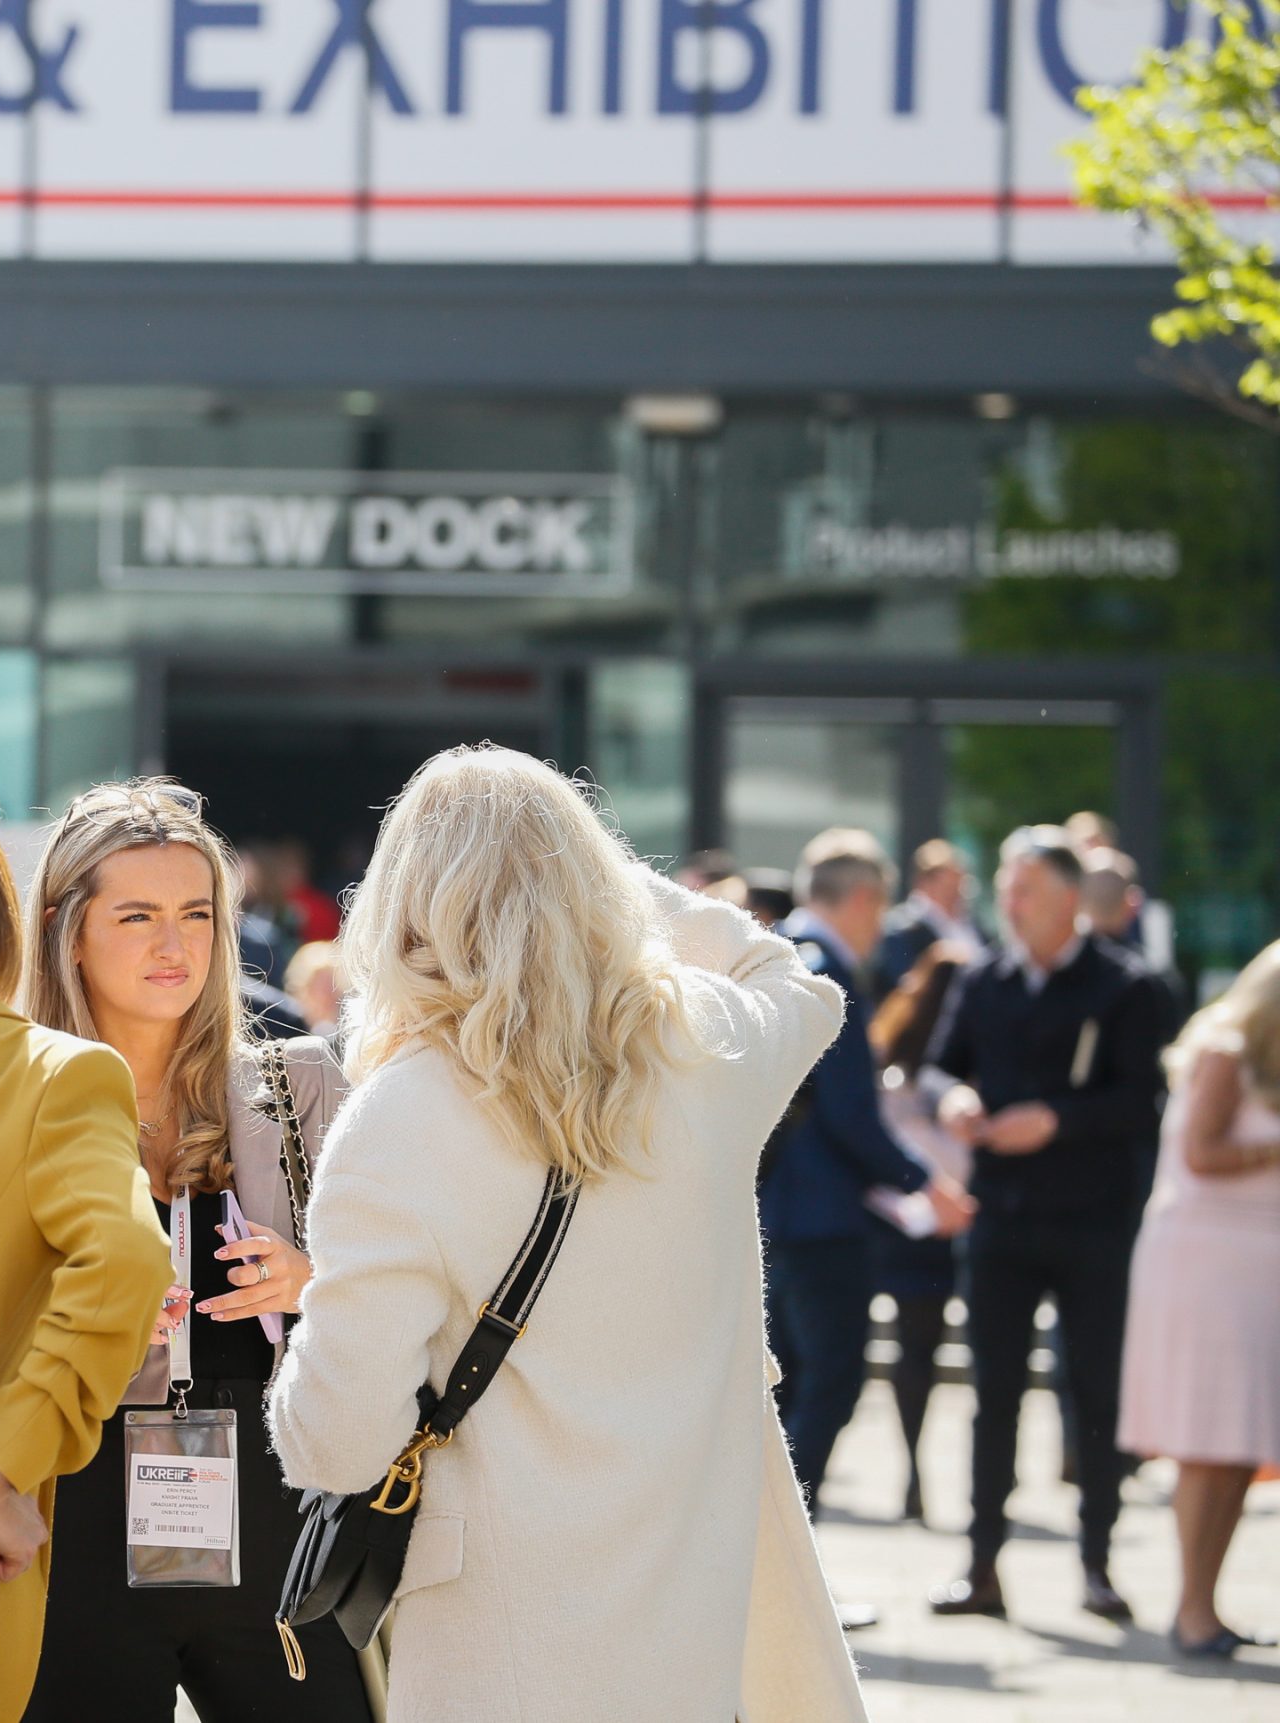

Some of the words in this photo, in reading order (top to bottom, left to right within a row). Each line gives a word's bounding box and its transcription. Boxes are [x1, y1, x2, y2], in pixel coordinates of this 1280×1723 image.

[141, 496, 340, 567] NEW
[351, 497, 593, 570] DOCK
[812, 522, 970, 579] Product
[975, 521, 1180, 580] Launches
